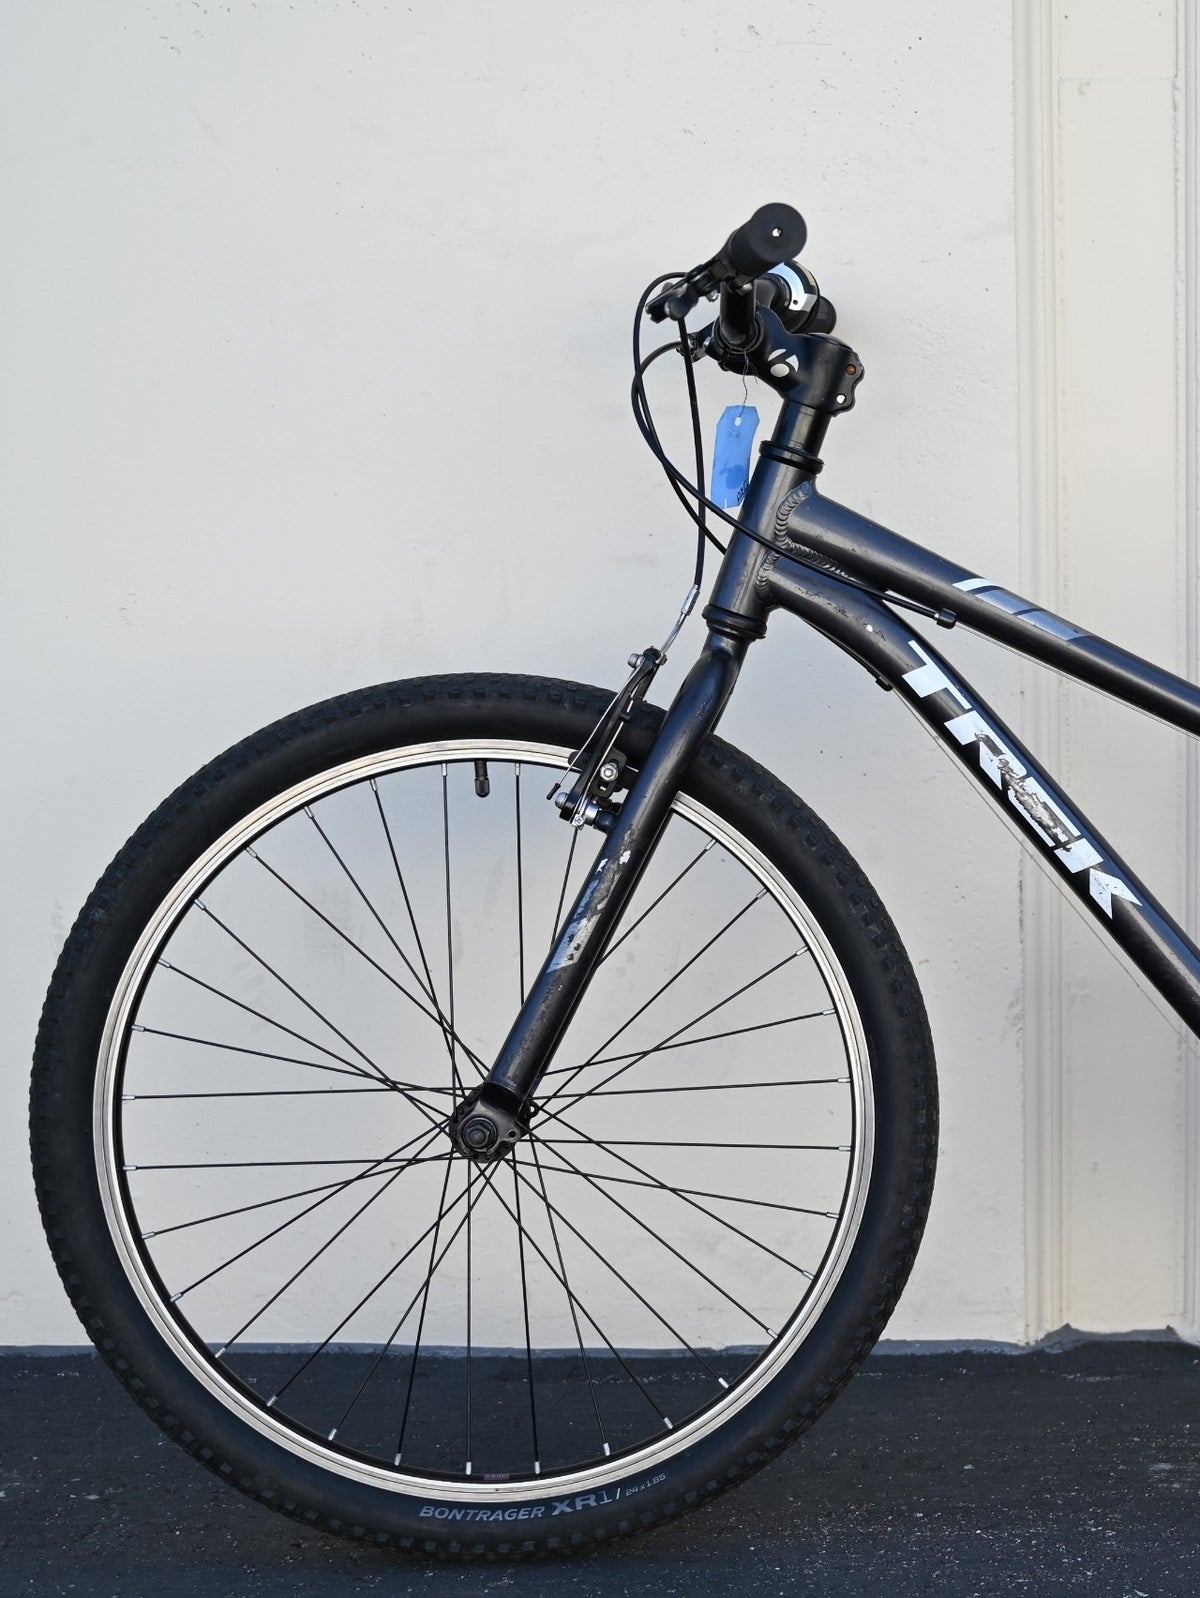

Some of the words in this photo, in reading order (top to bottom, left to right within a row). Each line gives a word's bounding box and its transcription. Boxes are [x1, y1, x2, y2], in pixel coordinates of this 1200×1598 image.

[901, 640, 1143, 919] TREK
[418, 1505, 546, 1521] BONTRAGER
[551, 1490, 613, 1516] XR1
